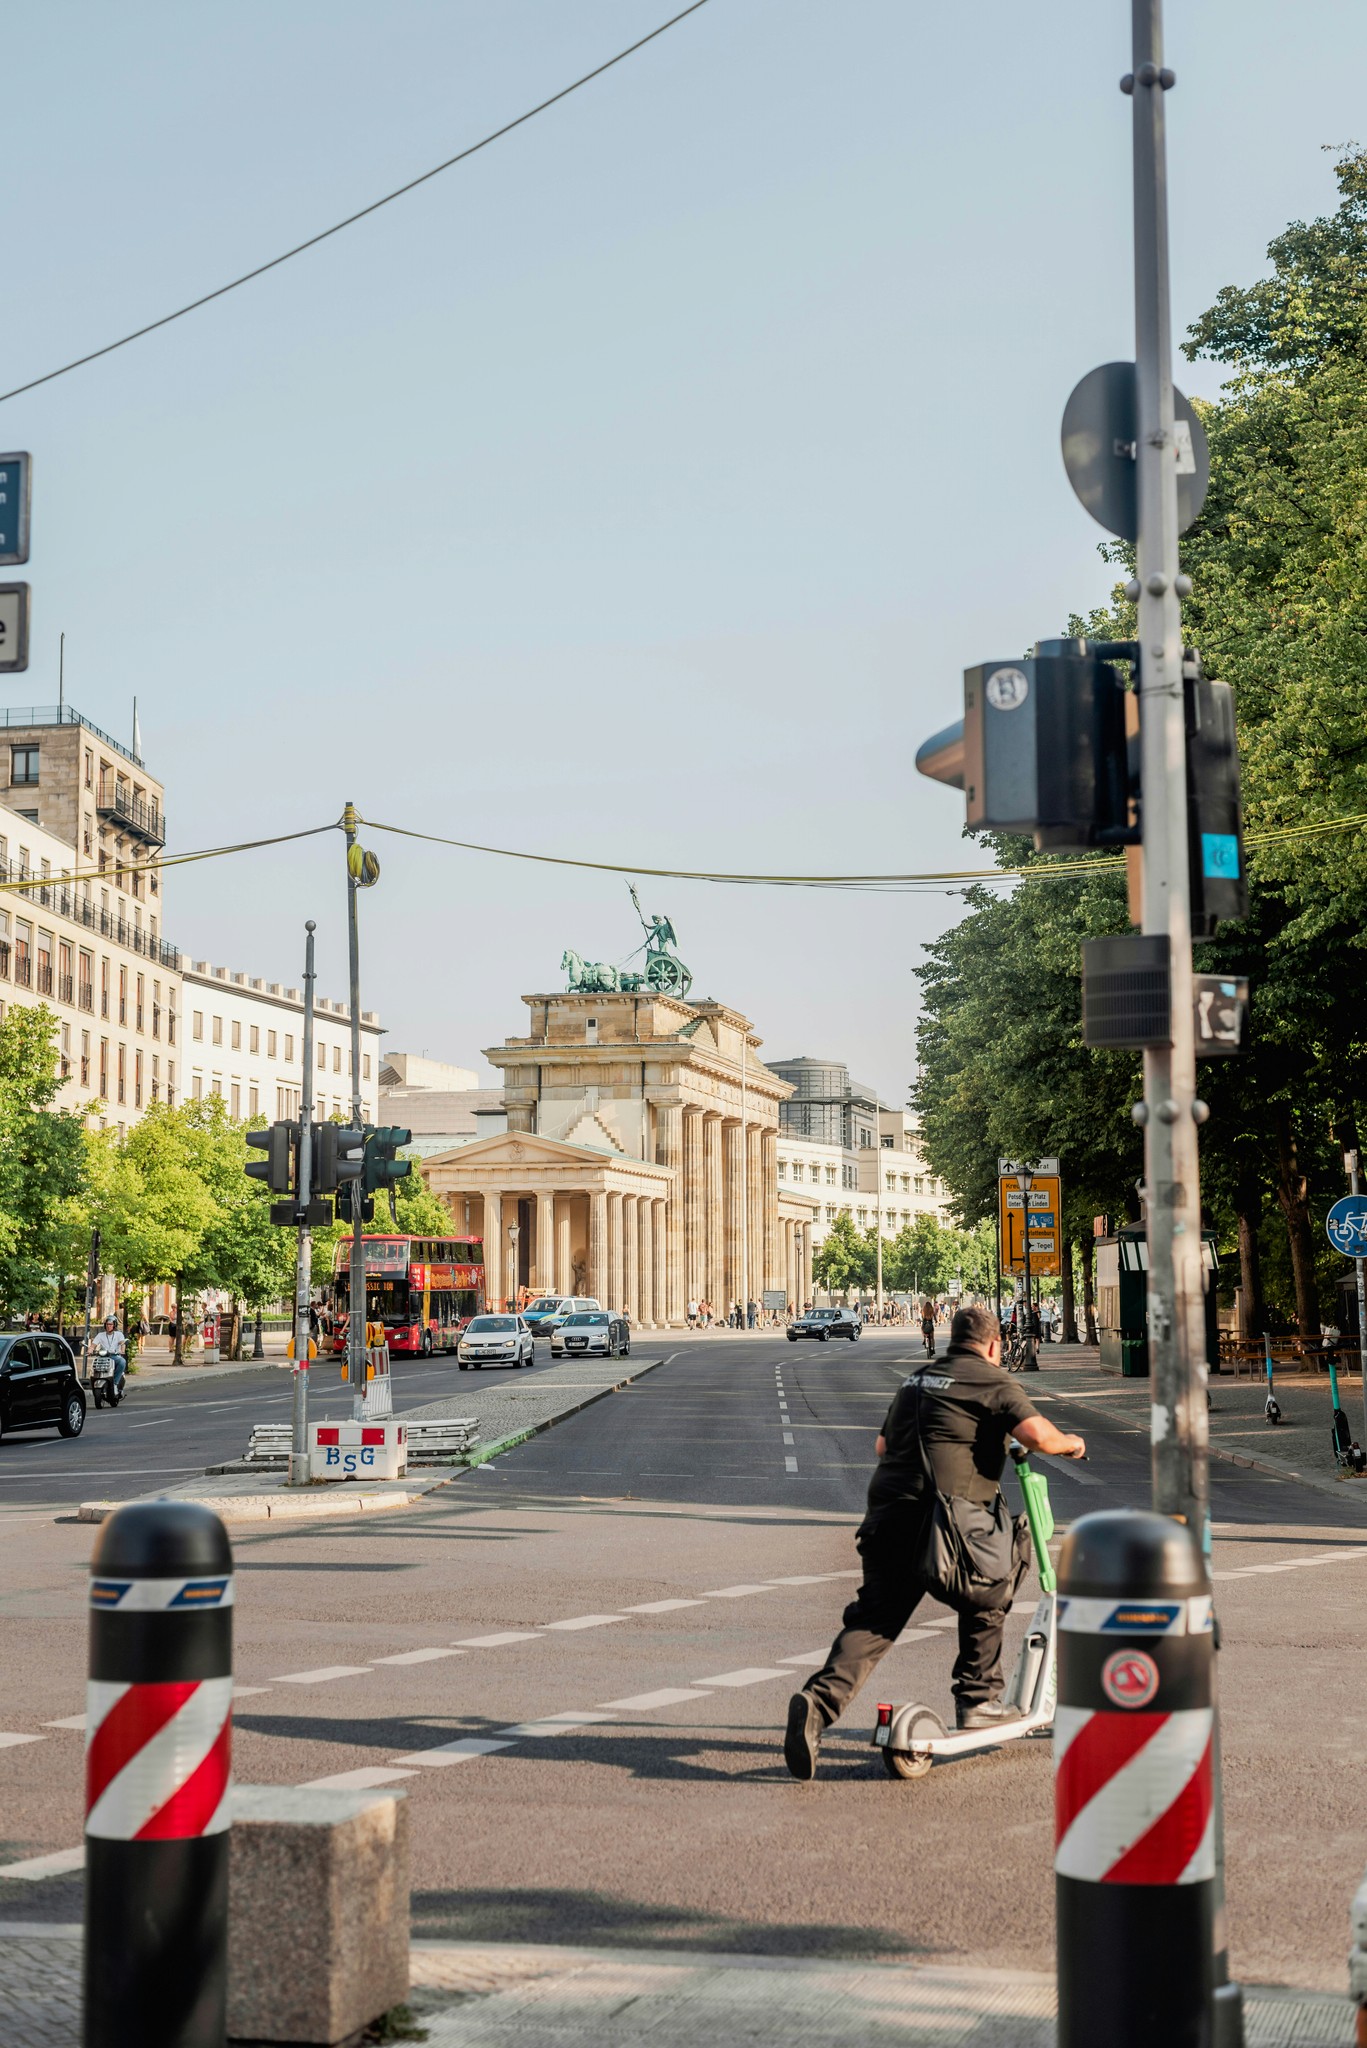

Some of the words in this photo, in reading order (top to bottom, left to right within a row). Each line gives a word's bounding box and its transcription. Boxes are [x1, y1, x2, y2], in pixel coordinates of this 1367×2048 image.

[1005, 1182, 1037, 1191] Kreurg
[1019, 1229, 1055, 1237] Crlottenburg
[1036, 1241, 1053, 1250] Tegel
[326, 1447, 375, 1472] BSG
